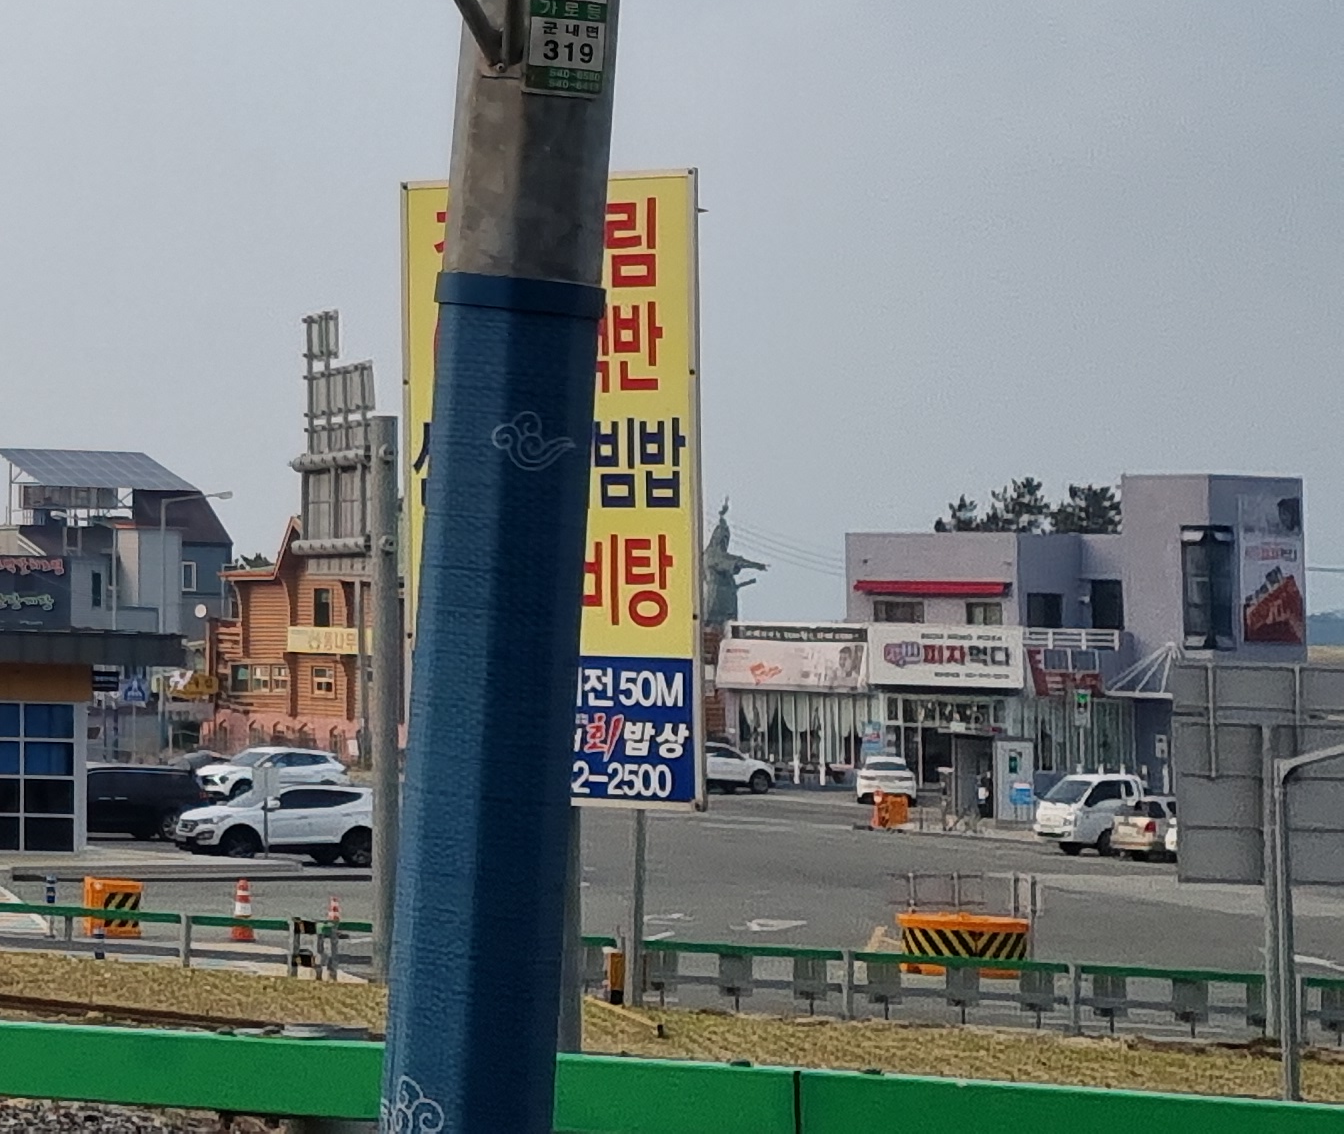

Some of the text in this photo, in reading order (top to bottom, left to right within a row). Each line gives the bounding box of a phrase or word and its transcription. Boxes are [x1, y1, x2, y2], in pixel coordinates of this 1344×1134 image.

[539, 0, 601, 19] 가로등
[543, 21, 599, 39] 군내면
[543, 40, 594, 63] 319
[576, 667, 684, 707] 전 50M
